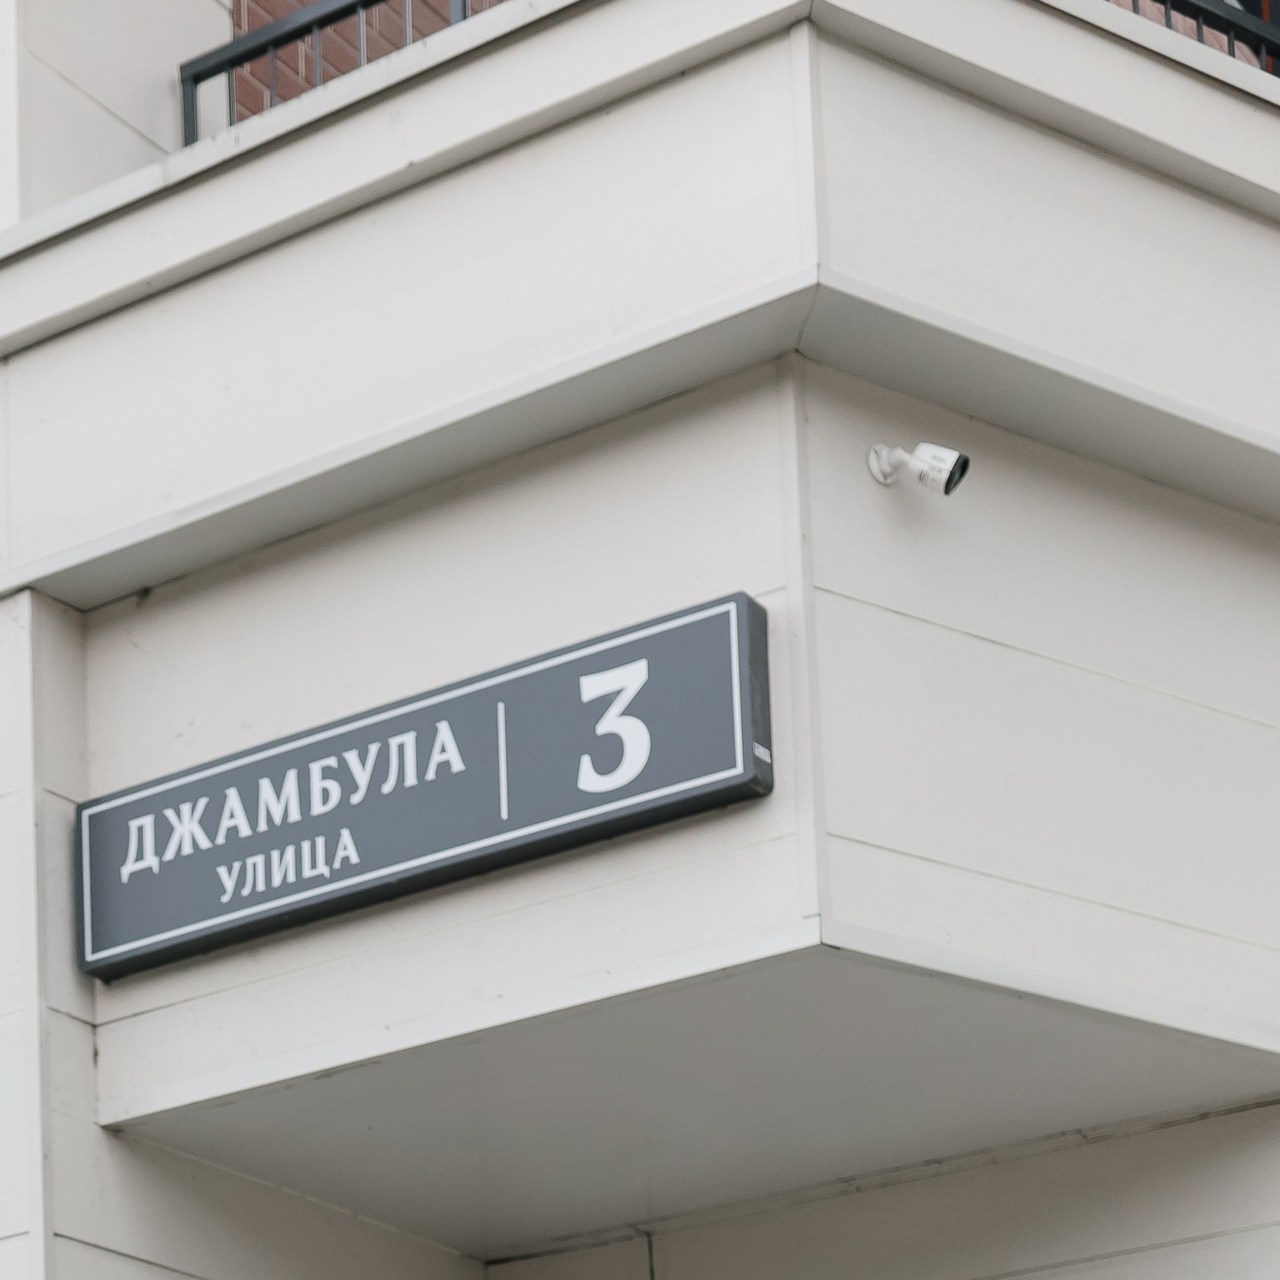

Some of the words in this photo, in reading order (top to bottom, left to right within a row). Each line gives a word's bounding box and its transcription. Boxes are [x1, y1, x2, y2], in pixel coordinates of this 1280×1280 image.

[576, 657, 652, 794] 3
[120, 719, 466, 884] ДЖАМБУЛА
[215, 827, 361, 904] УЛИЦА
